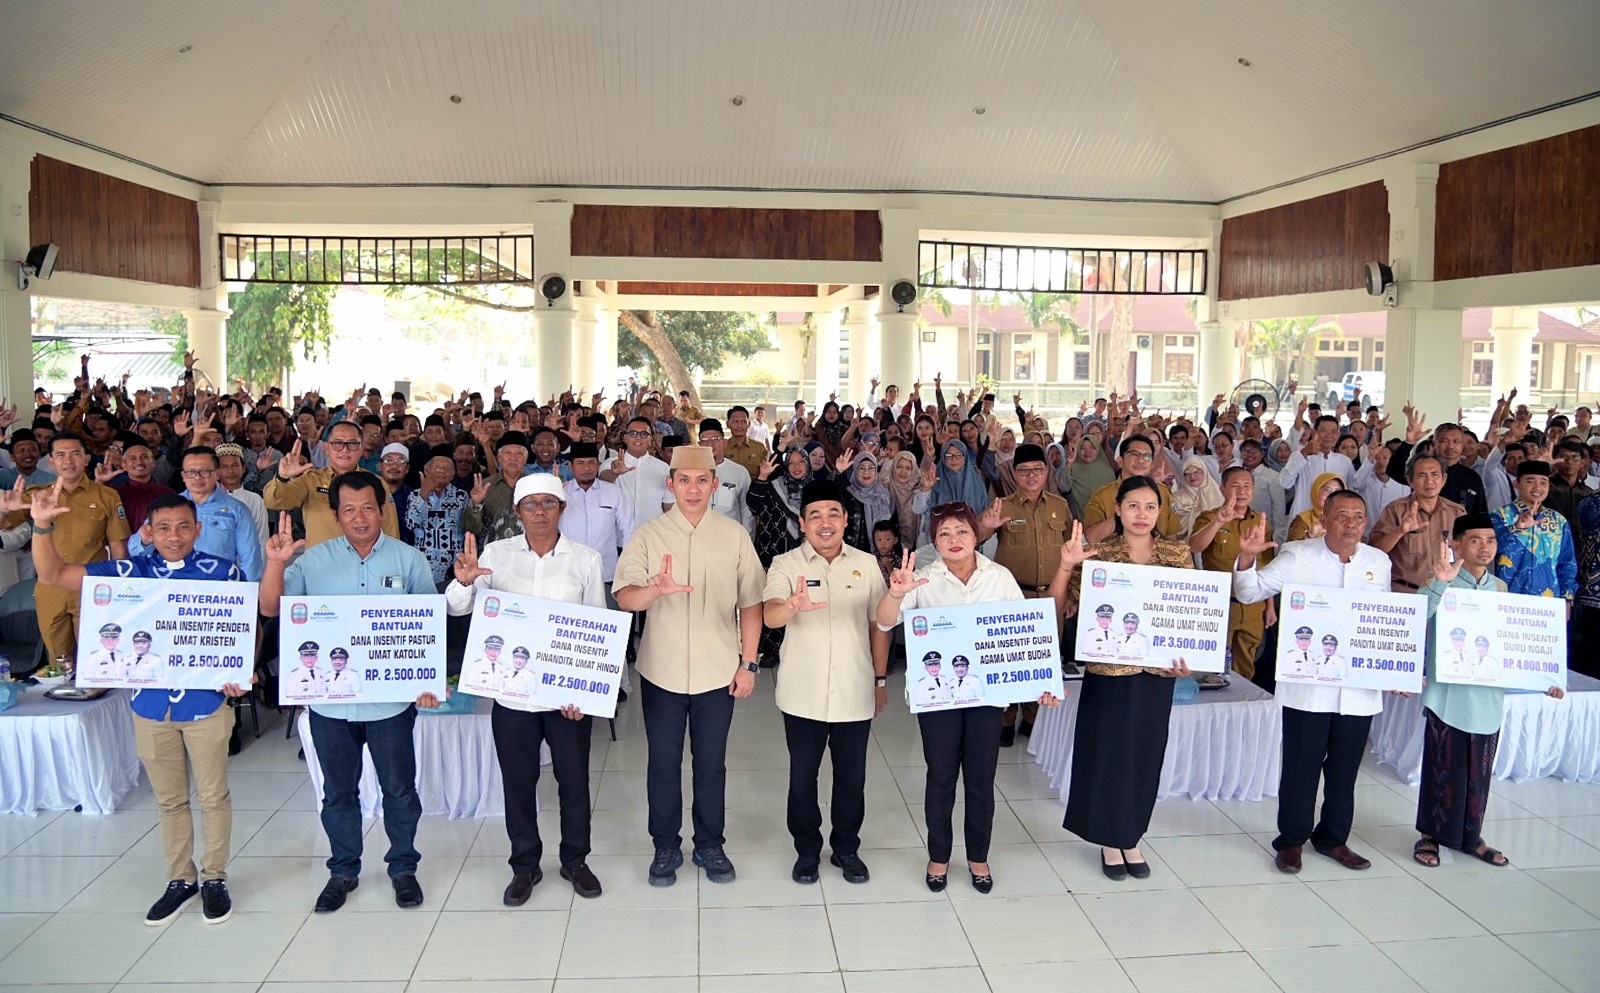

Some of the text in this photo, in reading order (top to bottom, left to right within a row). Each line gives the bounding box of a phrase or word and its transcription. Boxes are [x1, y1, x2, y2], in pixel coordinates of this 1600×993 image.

[1153, 580, 1218, 593] PENYERAHAN
[168, 594, 244, 605] PENYERAHAN
[1162, 593, 1208, 604] BANTUAN
[178, 608, 232, 617] BANTUAN
[361, 609, 433, 618] PENYERAHAN
[1143, 603, 1223, 617] DANA INSENTIF GURU
[1351, 602, 1415, 615] PENYERAHAN
[1498, 605, 1555, 617] PENYERAHAN
[549, 614, 617, 633] PENYERAHAN
[977, 612, 1043, 625] PENYERAHAN
[1151, 617, 1218, 632] AGAMA UMAT HINDU
[1360, 615, 1405, 626] BANTUAN
[1507, 617, 1547, 628] BANTUAN
[156, 620, 250, 632] DANA INSENTIF PENDETA
[372, 622, 423, 630] BANTUAN
[987, 625, 1035, 636] BANTUAN
[1357, 627, 1410, 638] DANA INSENTIF
[174, 635, 235, 646] UMAT KRISTEN
[351, 635, 435, 646] DANA INSENTIF PASTUR
[556, 629, 605, 643] BANTUAN
[975, 635, 1052, 650] DANA INSENTIF GURU
[1497, 631, 1559, 643] DANA INSENTIF
[551, 640, 609, 657] DANA INSENTIF
[1153, 636, 1217, 651] RP. 3.500.000
[1350, 639, 1417, 652] PANDITA UMAT BUDHA
[1504, 642, 1552, 655] GURU NGAJI
[369, 649, 426, 659] UMAT KATOLIK
[980, 649, 1051, 665] AGAMA UMAT BUDHA
[169, 655, 243, 668] RP. 2.500.000
[536, 652, 620, 674] PINANDITA UMAT HINDU
[1352, 657, 1415, 672] RP. 3.500.000
[1517, 660, 1559, 673] 4.000.000
[365, 668, 436, 680] RP. 2.500.000
[986, 668, 1052, 684] RP. 2.500.000
[542, 673, 610, 695] RP. 2.500.000
